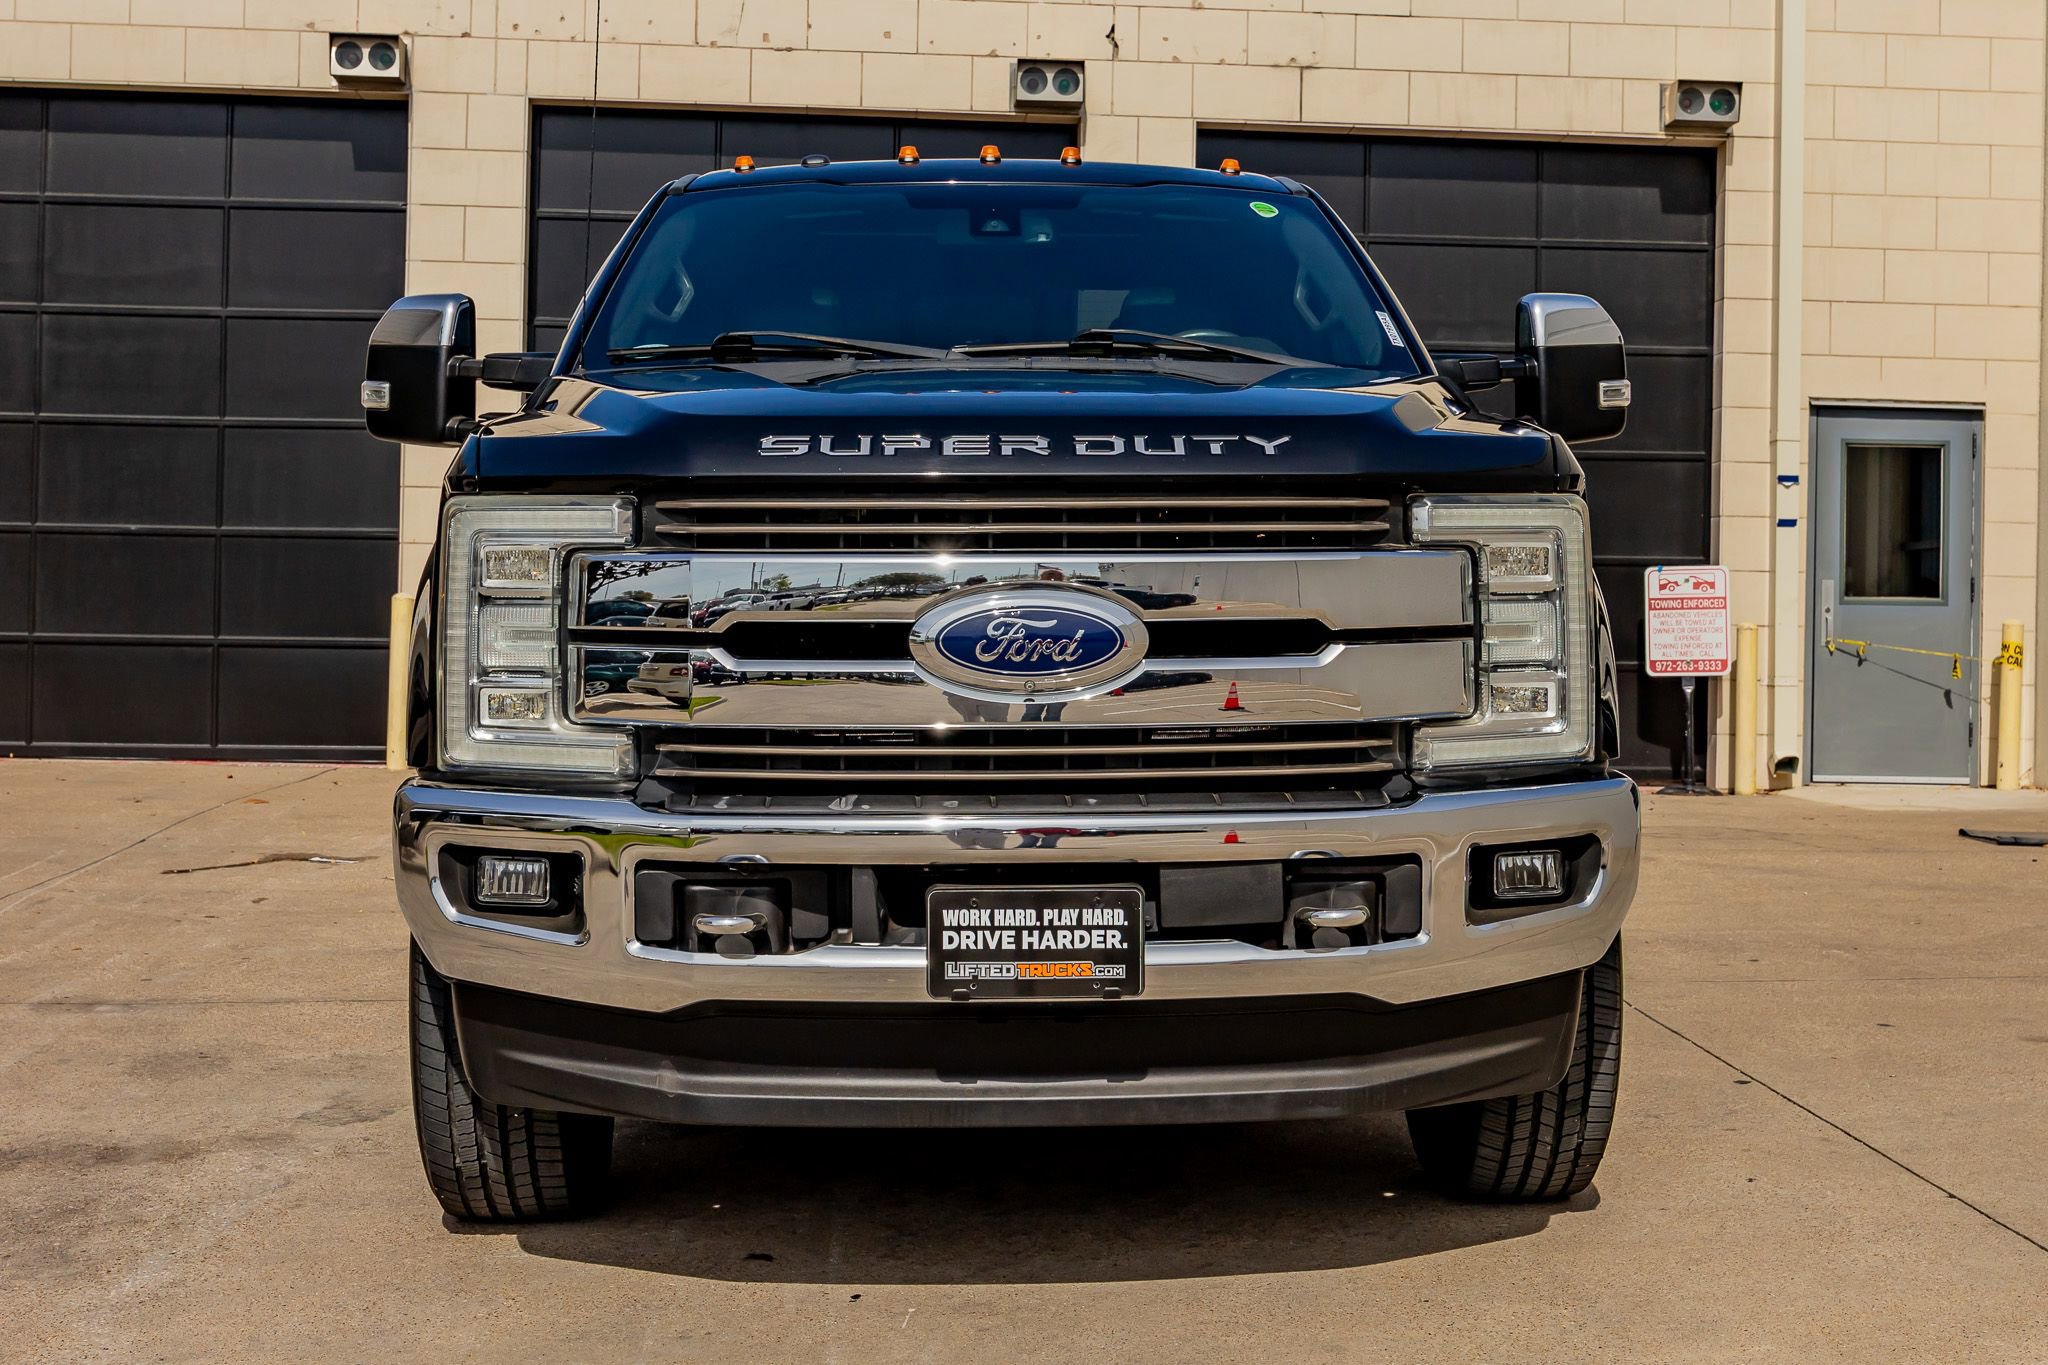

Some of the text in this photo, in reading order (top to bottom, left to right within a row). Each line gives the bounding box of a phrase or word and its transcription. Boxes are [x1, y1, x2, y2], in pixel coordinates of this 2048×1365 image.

[758, 435, 1292, 457] SUPER DUTY
[1650, 599, 1725, 609] TOWING ENFORCED
[1653, 611, 1691, 619] ABANDONED
[1653, 627, 1675, 635] OWNER
[975, 617, 1085, 662] Ford
[1655, 661, 1722, 671] 972-263-9333
[942, 908, 1128, 926] WORK HARD. PLAY HARD.
[942, 930, 1128, 950] DRIVE HARDER.
